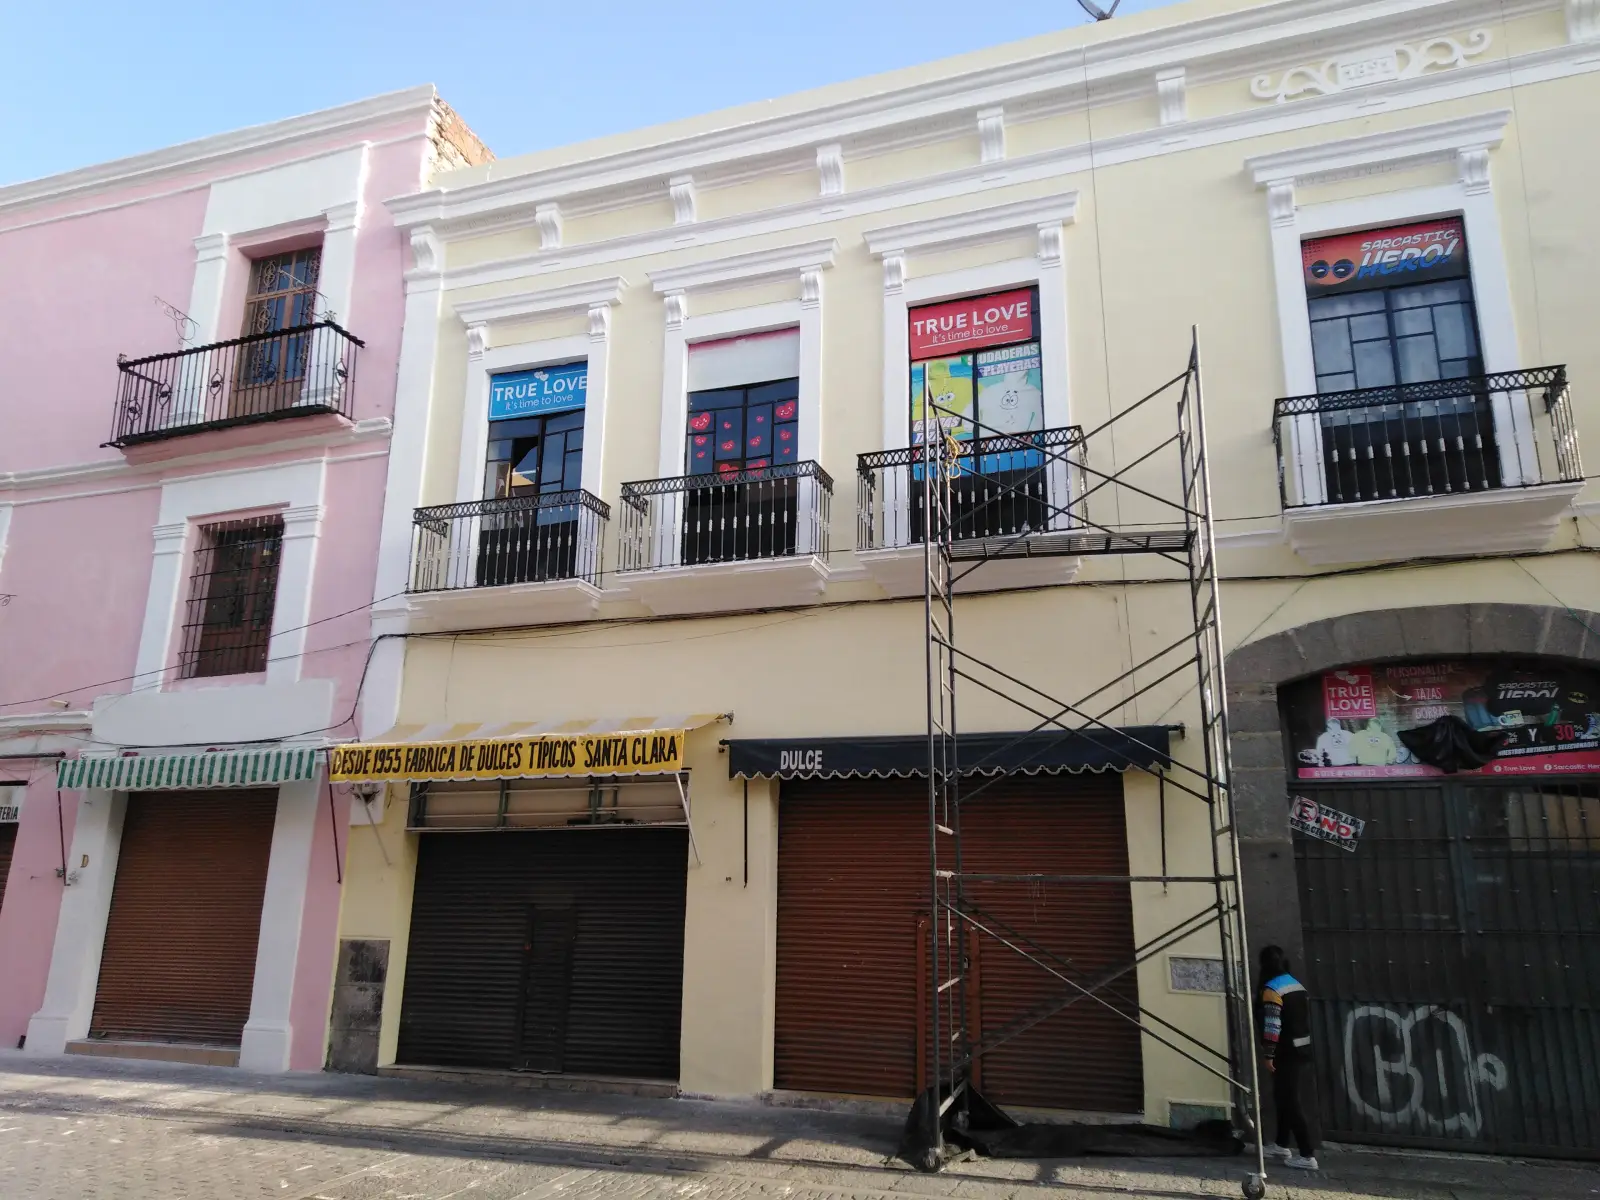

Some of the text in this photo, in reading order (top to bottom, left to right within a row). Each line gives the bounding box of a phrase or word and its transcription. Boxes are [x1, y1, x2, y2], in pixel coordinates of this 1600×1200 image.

[1360, 230, 1456, 252] SARCASTIC
[1357, 238, 1460, 280] HERO!
[913, 302, 1028, 336] TRUE LOVE
[948, 330, 970, 342] time
[972, 327, 984, 337] to
[986, 323, 1009, 334] love
[494, 376, 587, 401] TRUE LOVE
[520, 398, 539, 409] time
[541, 396, 552, 405] to
[553, 393, 574, 404] love
[1328, 685, 1371, 698] TRUE
[1415, 687, 1443, 700] TAZAS
[1497, 681, 1557, 690] SARCASTIC
[1329, 698, 1372, 711] LOVE
[1528, 728, 1538, 742] Y
[331, 747, 373, 775] DESDE
[372, 747, 402, 774] 1955
[404, 746, 455, 773] FABRICA
[459, 745, 475, 771] DE
[476, 742, 523, 771] DULCES
[529, 736, 577, 769] TÍPICOS
[780, 750, 823, 770] DULCE
[1320, 817, 1351, 838] NO
[80, 854, 89, 868] D
